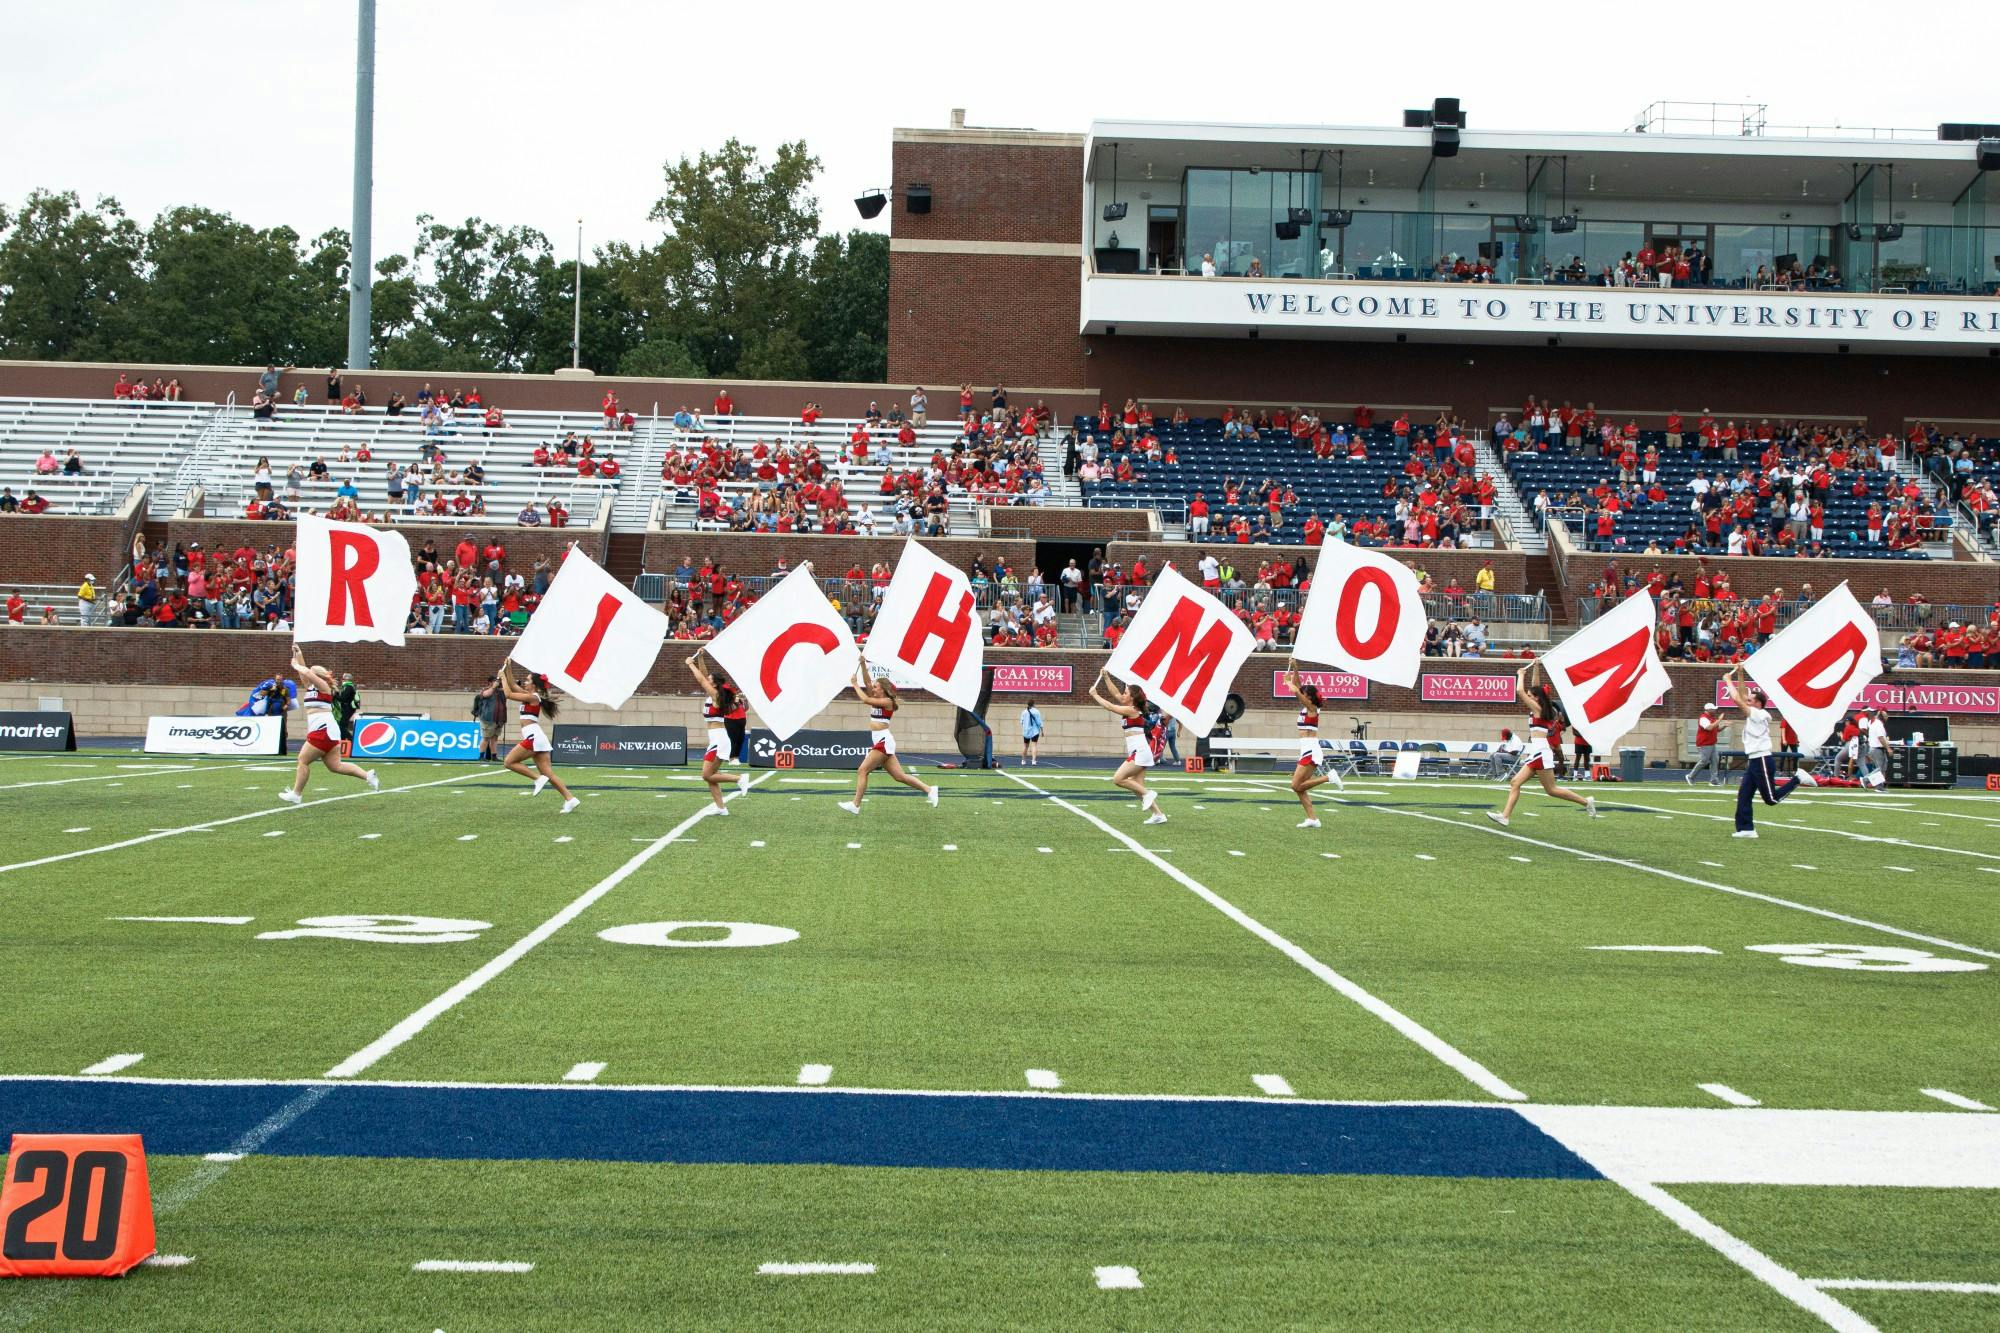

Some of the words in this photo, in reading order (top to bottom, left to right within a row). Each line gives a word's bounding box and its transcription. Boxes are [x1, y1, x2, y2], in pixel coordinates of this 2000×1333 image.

[1246, 293, 1436, 316] WELCOME
[1460, 299, 1506, 318] TO
[1535, 301, 1604, 320] THE
[1628, 303, 1868, 327] UNIVERSITY
[1892, 310, 1938, 328] OF
[326, 530, 380, 627] R
[897, 572, 975, 681] H
[759, 622, 840, 701] C
[1131, 595, 1233, 713] M
[1033, 668, 1064, 681] 1984
[1565, 626, 1651, 723] N
[1778, 622, 1867, 709] D
[1330, 675, 1360, 687] 1998
[1430, 678, 1473, 690] NCAA
[1476, 678, 1508, 690] 2000
[1875, 689, 1996, 706] CHAMPIONS
[168, 726, 252, 740] image360
[400, 729, 479, 753] pepsi
[557, 742, 592, 750] YEATMAN
[781, 744, 830, 756] CoStar
[777, 752, 793, 766] 20
[1187, 757, 1203, 771] 30
[2, 1149, 128, 1261] 20
